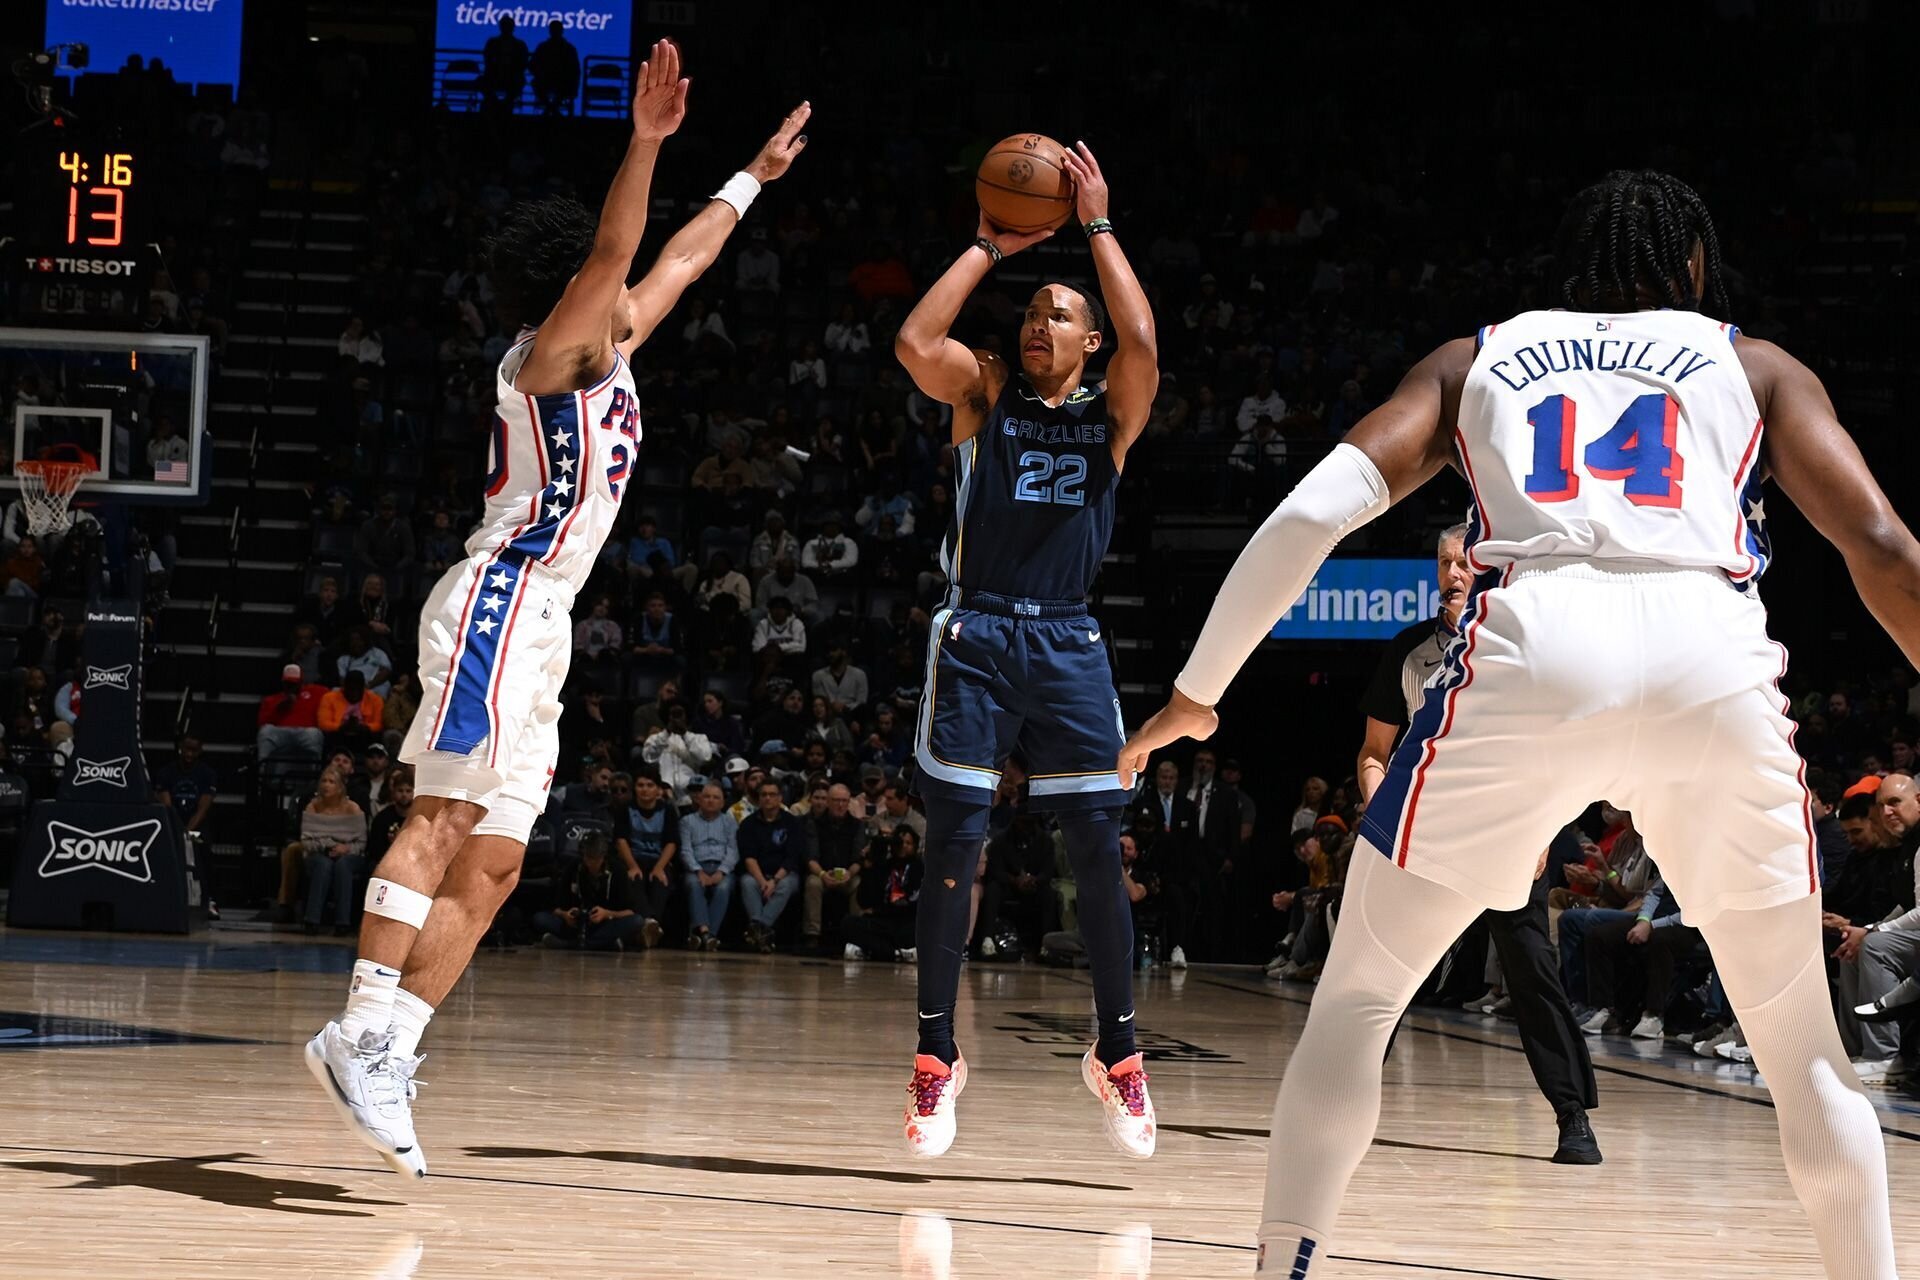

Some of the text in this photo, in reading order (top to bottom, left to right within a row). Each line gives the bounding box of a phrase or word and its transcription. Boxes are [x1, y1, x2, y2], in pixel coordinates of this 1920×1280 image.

[59, 152, 133, 186] 4:16
[68, 187, 123, 246] 13
[56, 258, 136, 276] TISSOT
[1490, 339, 1716, 391] COUNCIL IV
[1003, 417, 1106, 444] GRIZZLIES
[1524, 393, 1684, 510] 14
[606, 444, 636, 503] 2
[1015, 450, 1088, 506] 22
[88, 612, 136, 622] FedForum
[91, 672, 125, 682] SONIC
[80, 766, 123, 778] SONIC
[55, 838, 142, 862] SONIC
